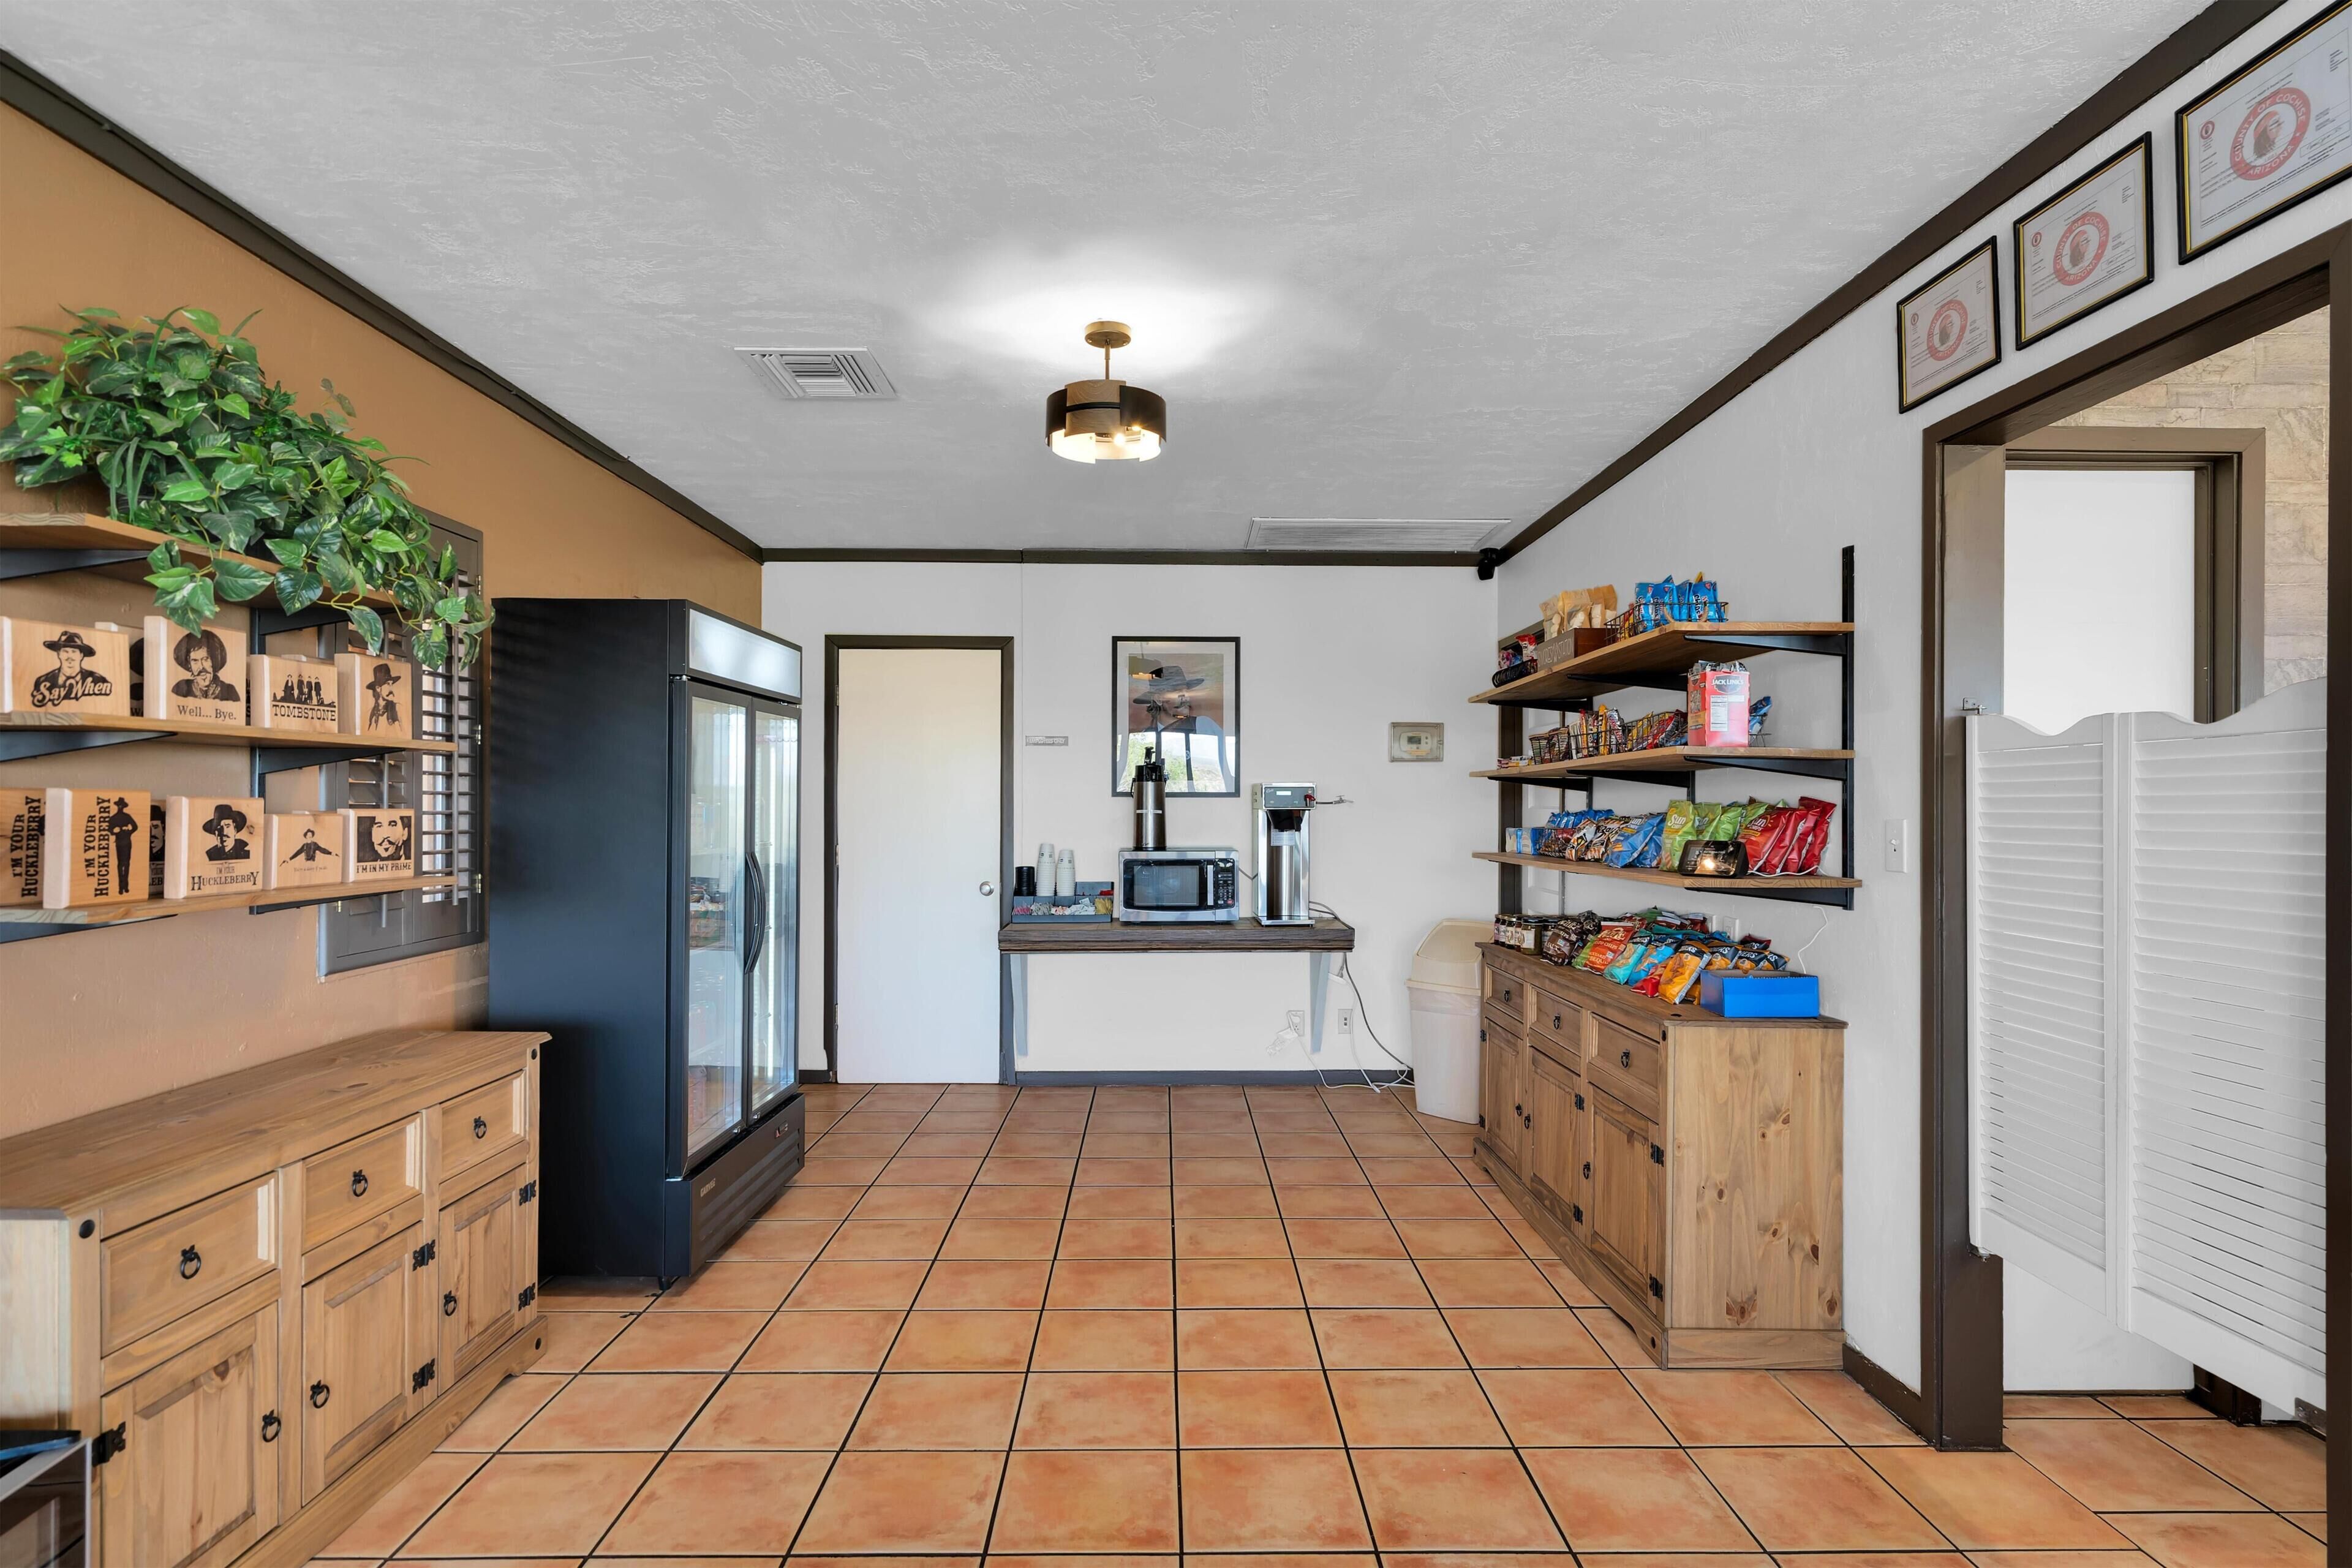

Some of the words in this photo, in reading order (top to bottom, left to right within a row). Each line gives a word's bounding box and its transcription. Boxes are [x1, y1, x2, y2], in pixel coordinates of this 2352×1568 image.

[2234, 116, 2254, 161] COUNTY
[2258, 99, 2274, 113] OF
[2275, 93, 2307, 122] COCHISE
[2247, 145, 2294, 175] ARIZONA
[2084, 216, 2106, 241] COCHISE
[2065, 260, 2098, 281] ARIZONA
[32, 681, 69, 706] Say
[66, 676, 111, 698] When
[177, 704, 212, 718] Well...
[215, 708, 236, 722] Bye.
[272, 704, 336, 722] TOMBSTONE
[1667, 813, 1687, 827] Sun
[10, 813, 25, 853] YOUR
[83, 815, 96, 854] YOUR
[21, 796, 41, 897] HUCKLEBERRY
[94, 796, 111, 897] HUCKLEBERRY
[11, 857, 23, 878] I'M
[85, 858, 96, 878] I'M
[356, 864, 368, 873] I'M
[369, 864, 377, 873] IN
[379, 862, 389, 872] MY
[391, 862, 412, 871] PRIME
[190, 871, 259, 891] HUCKLEBERRY
